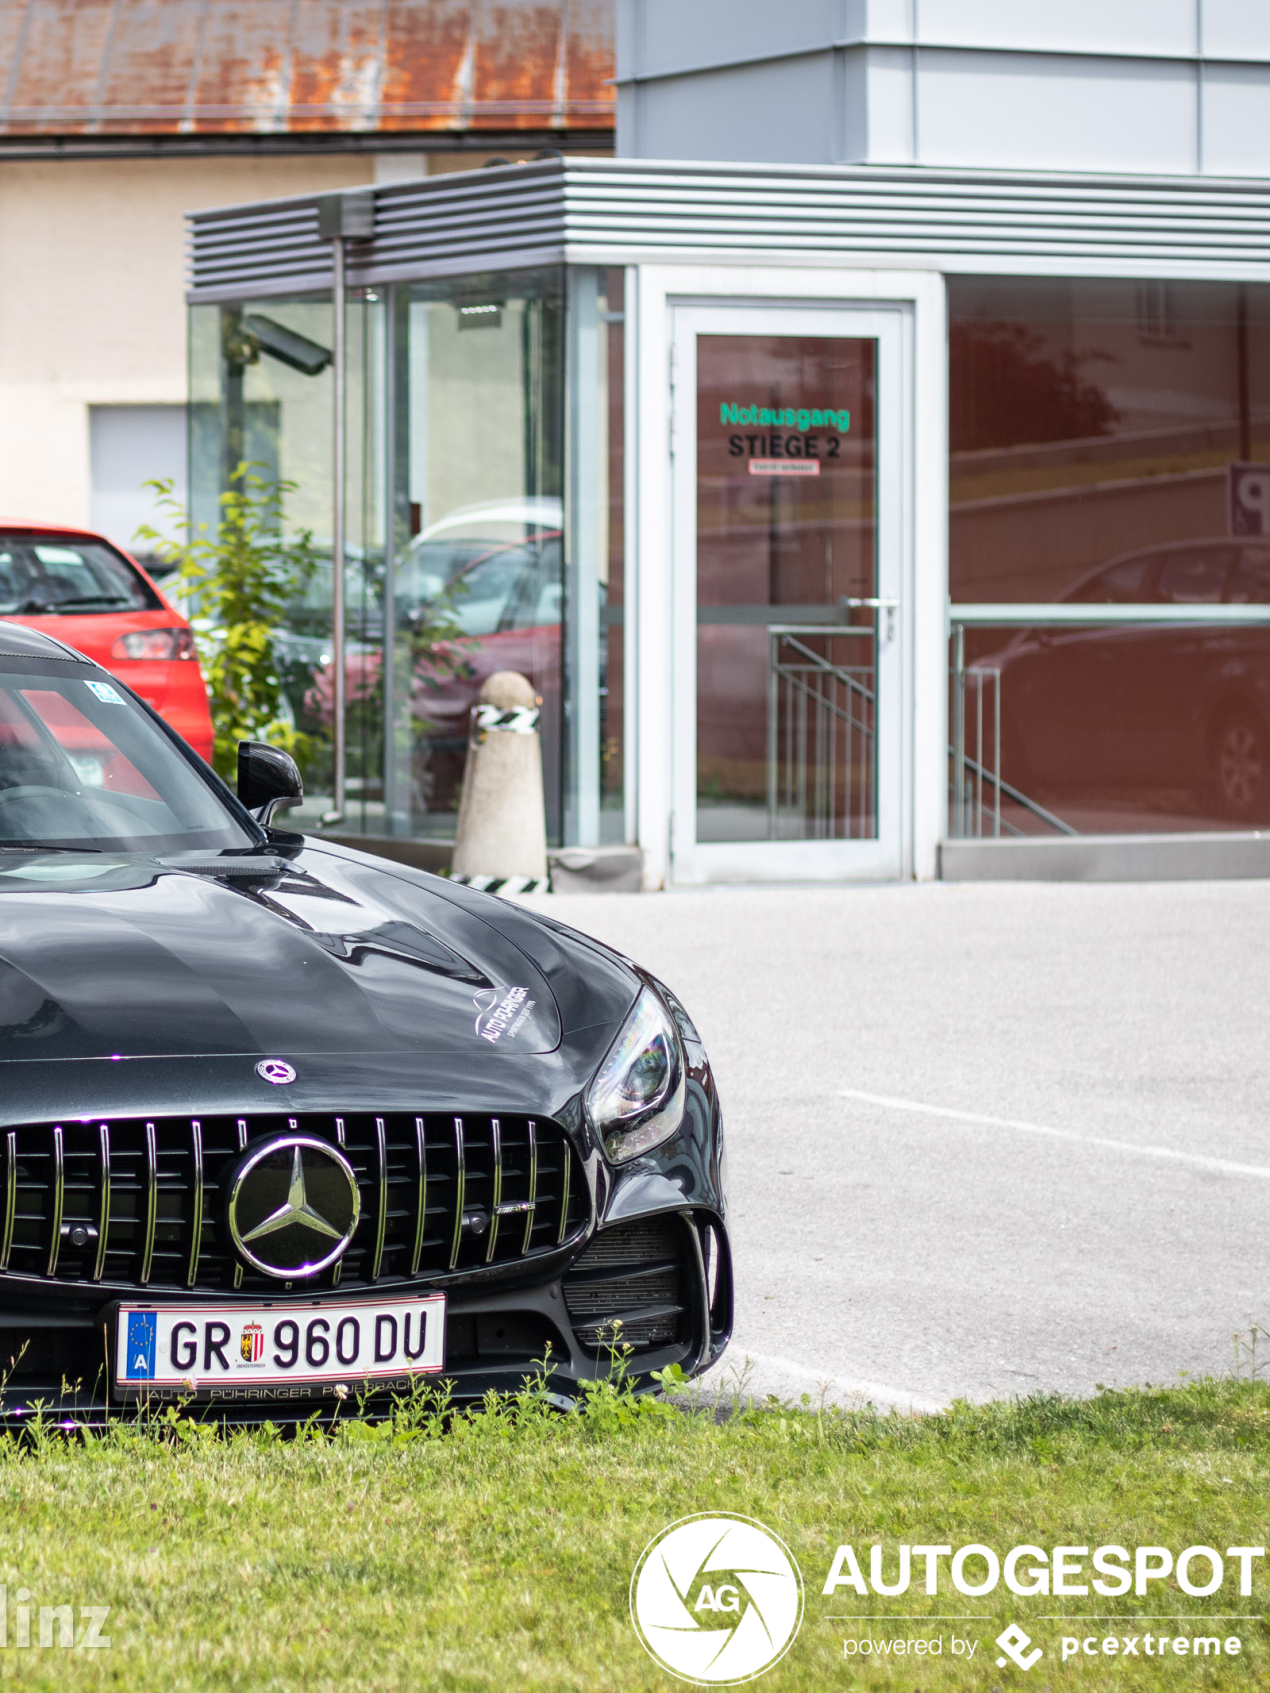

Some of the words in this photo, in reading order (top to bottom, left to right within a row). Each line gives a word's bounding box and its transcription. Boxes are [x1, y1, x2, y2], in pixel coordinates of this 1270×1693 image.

[720, 402, 850, 432] Notausgang
[729, 435, 819, 458] STIEGE
[827, 435, 840, 458] 2
[481, 1018, 506, 1043] AUTO
[133, 1354, 147, 1370] A
[170, 1321, 231, 1371] GR
[273, 1316, 360, 1369] 960
[374, 1310, 427, 1363] DU
[149, 1390, 198, 1400] AUTO
[210, 1387, 311, 1400] PÜHRINGER
